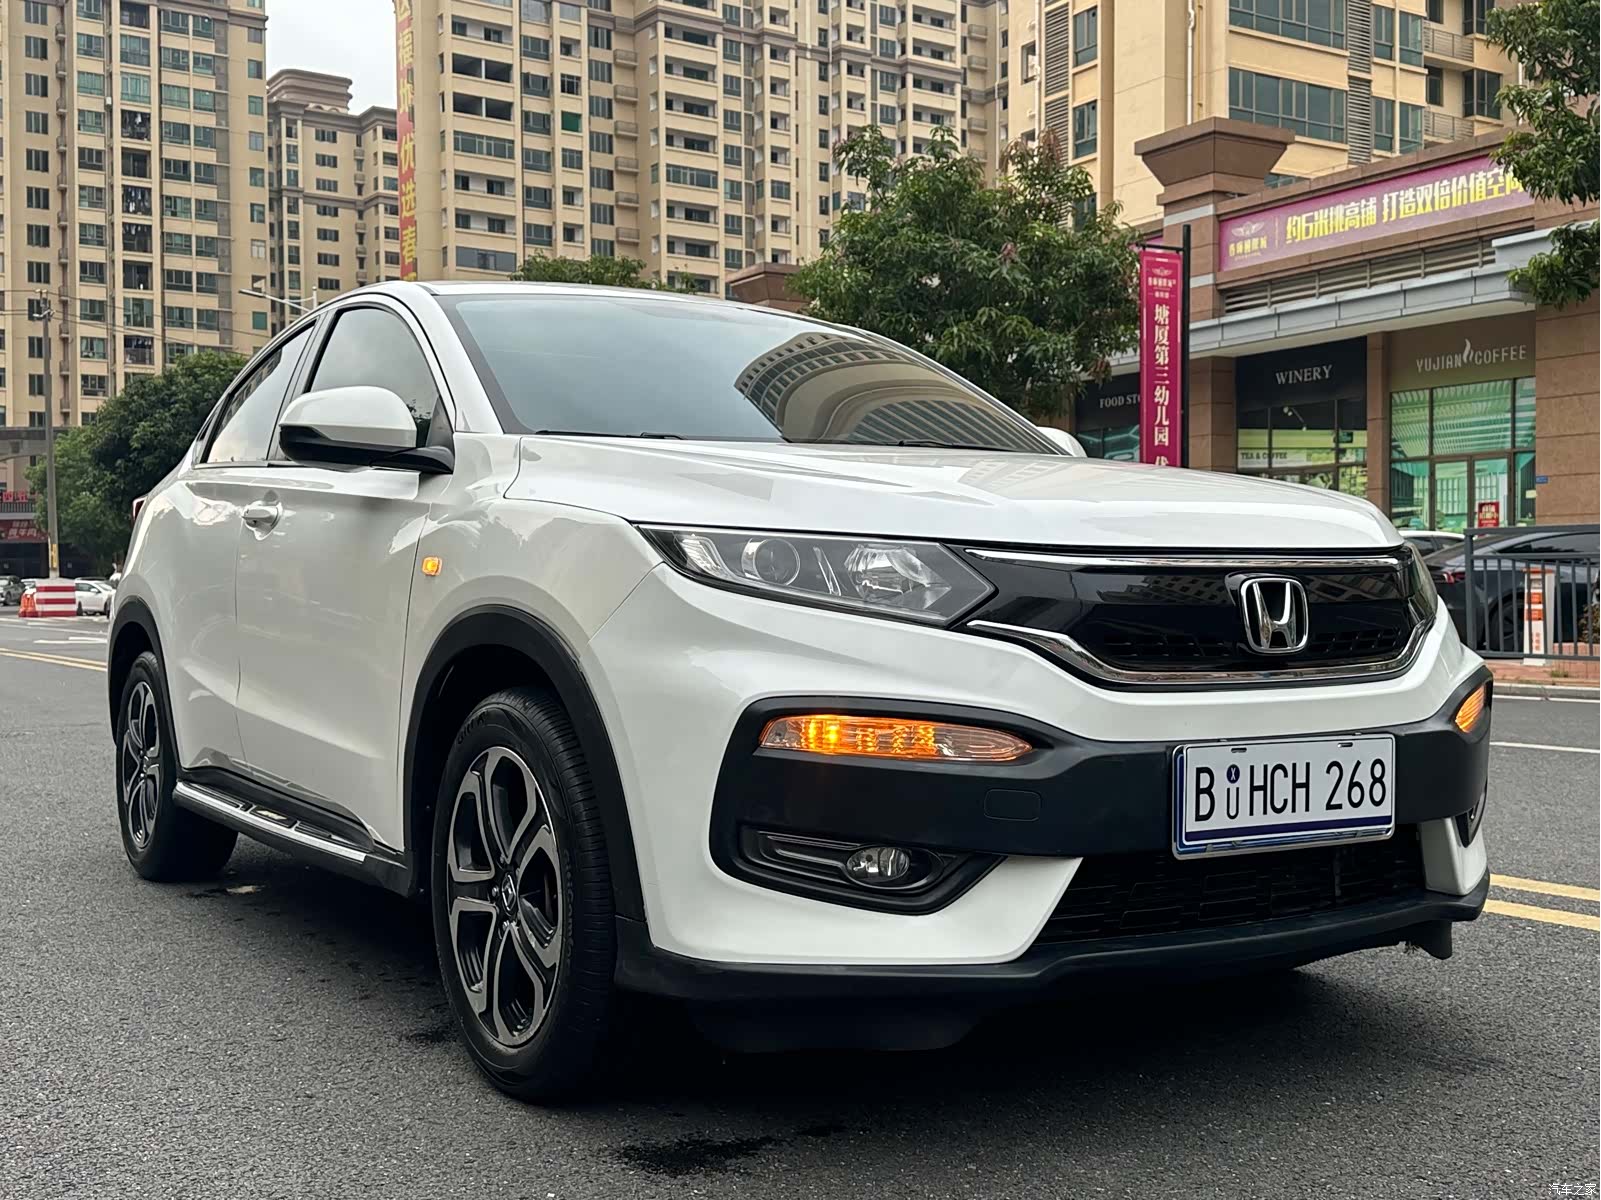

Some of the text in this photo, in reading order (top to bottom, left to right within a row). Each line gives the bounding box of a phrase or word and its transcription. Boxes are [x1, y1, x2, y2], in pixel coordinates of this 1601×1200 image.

[1415, 344, 1527, 373] YUJIAN COFFEE
[1153, 303, 1170, 447] 塘厦第三幼儿园
[1275, 364, 1333, 385] WINERY
[1099, 395, 1125, 409] FOOD
[1325, 758, 1387, 811] 268
